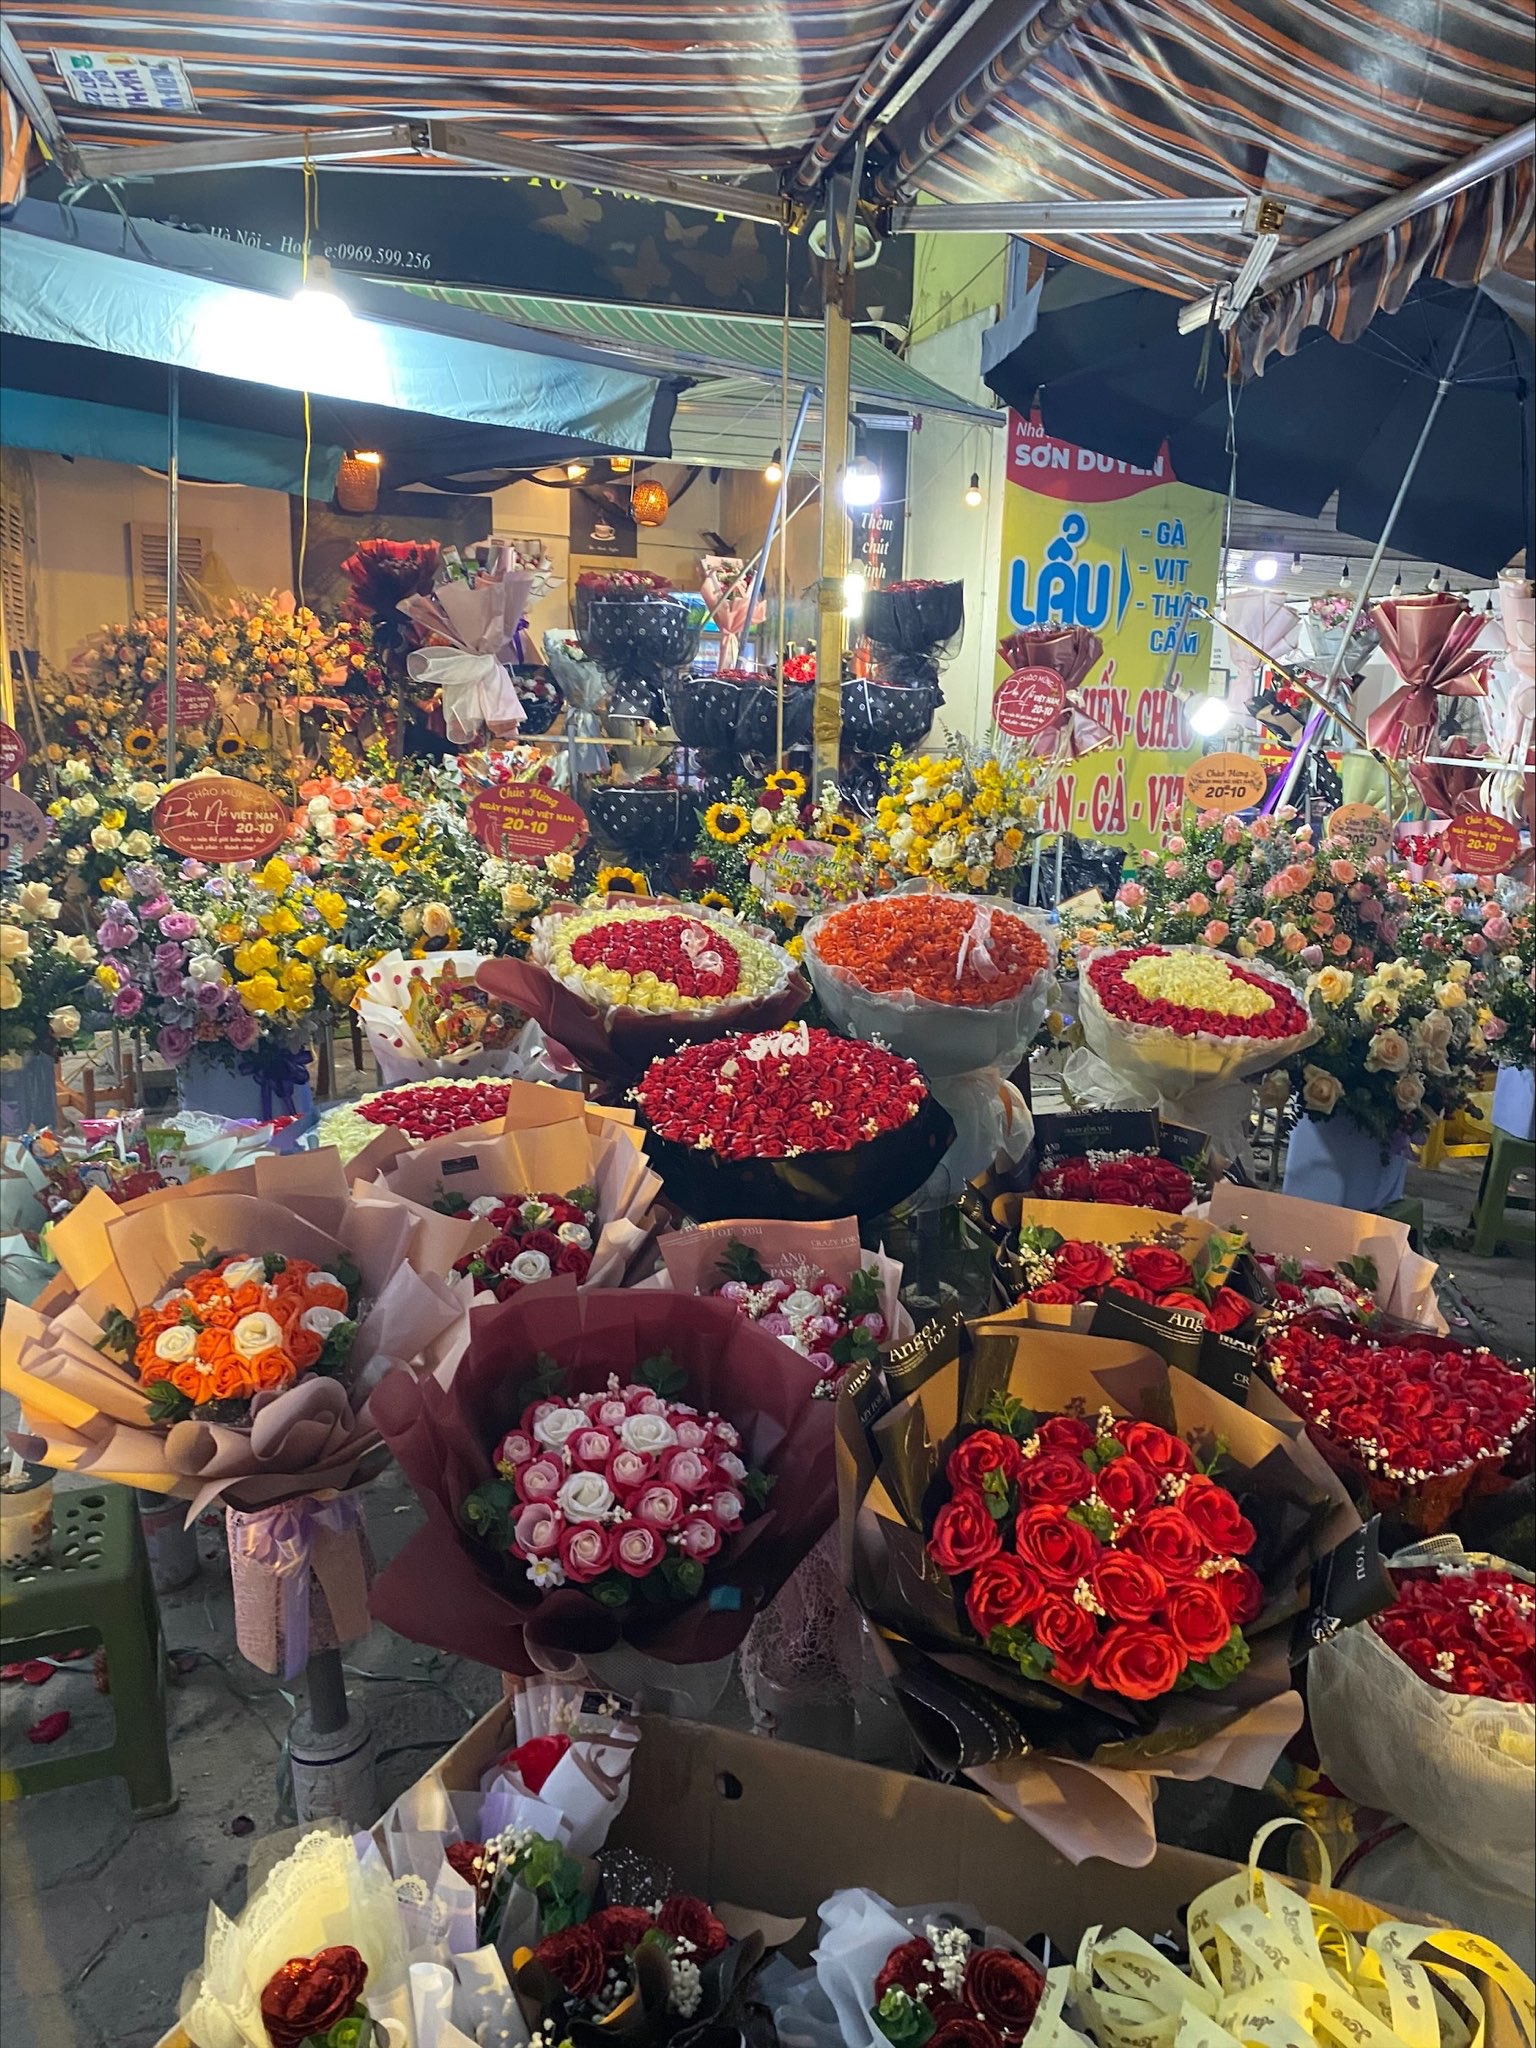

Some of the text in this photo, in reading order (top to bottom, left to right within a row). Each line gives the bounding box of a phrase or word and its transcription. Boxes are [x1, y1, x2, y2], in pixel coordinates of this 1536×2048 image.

[1016, 422, 1044, 438] Nhà
[1015, 443, 1070, 470] SƠN
[860, 512, 893, 532] Thêm
[1156, 518, 1185, 546] GÀ
[862, 538, 890, 556] chút
[1010, 513, 1111, 629] LẨU
[1154, 558, 1189, 586] VỊT
[1030, 704, 1054, 716] 20-10
[187, 787, 218, 801] CHÀO
[1091, 758, 1126, 832] GÀ
[1205, 786, 1246, 798] 20-10
[230, 811, 253, 823] VIỆT
[255, 811, 279, 821] NAM
[479, 802, 575, 823] NGÀY PHỤ NỮ VIỆT NAM
[236, 823, 275, 834] 20-10
[502, 817, 549, 835] 20-10
[1466, 838, 1497, 852] 20-10
[742, 1225, 763, 1237] you
[889, 1317, 939, 1362] Angel
[1282, 1905, 1304, 1946] Love
[1254, 1936, 1290, 1971] Love
[1121, 1961, 1161, 1989] Love
[1392, 1955, 1417, 1990] Love
[1331, 2007, 1373, 2045] Love
